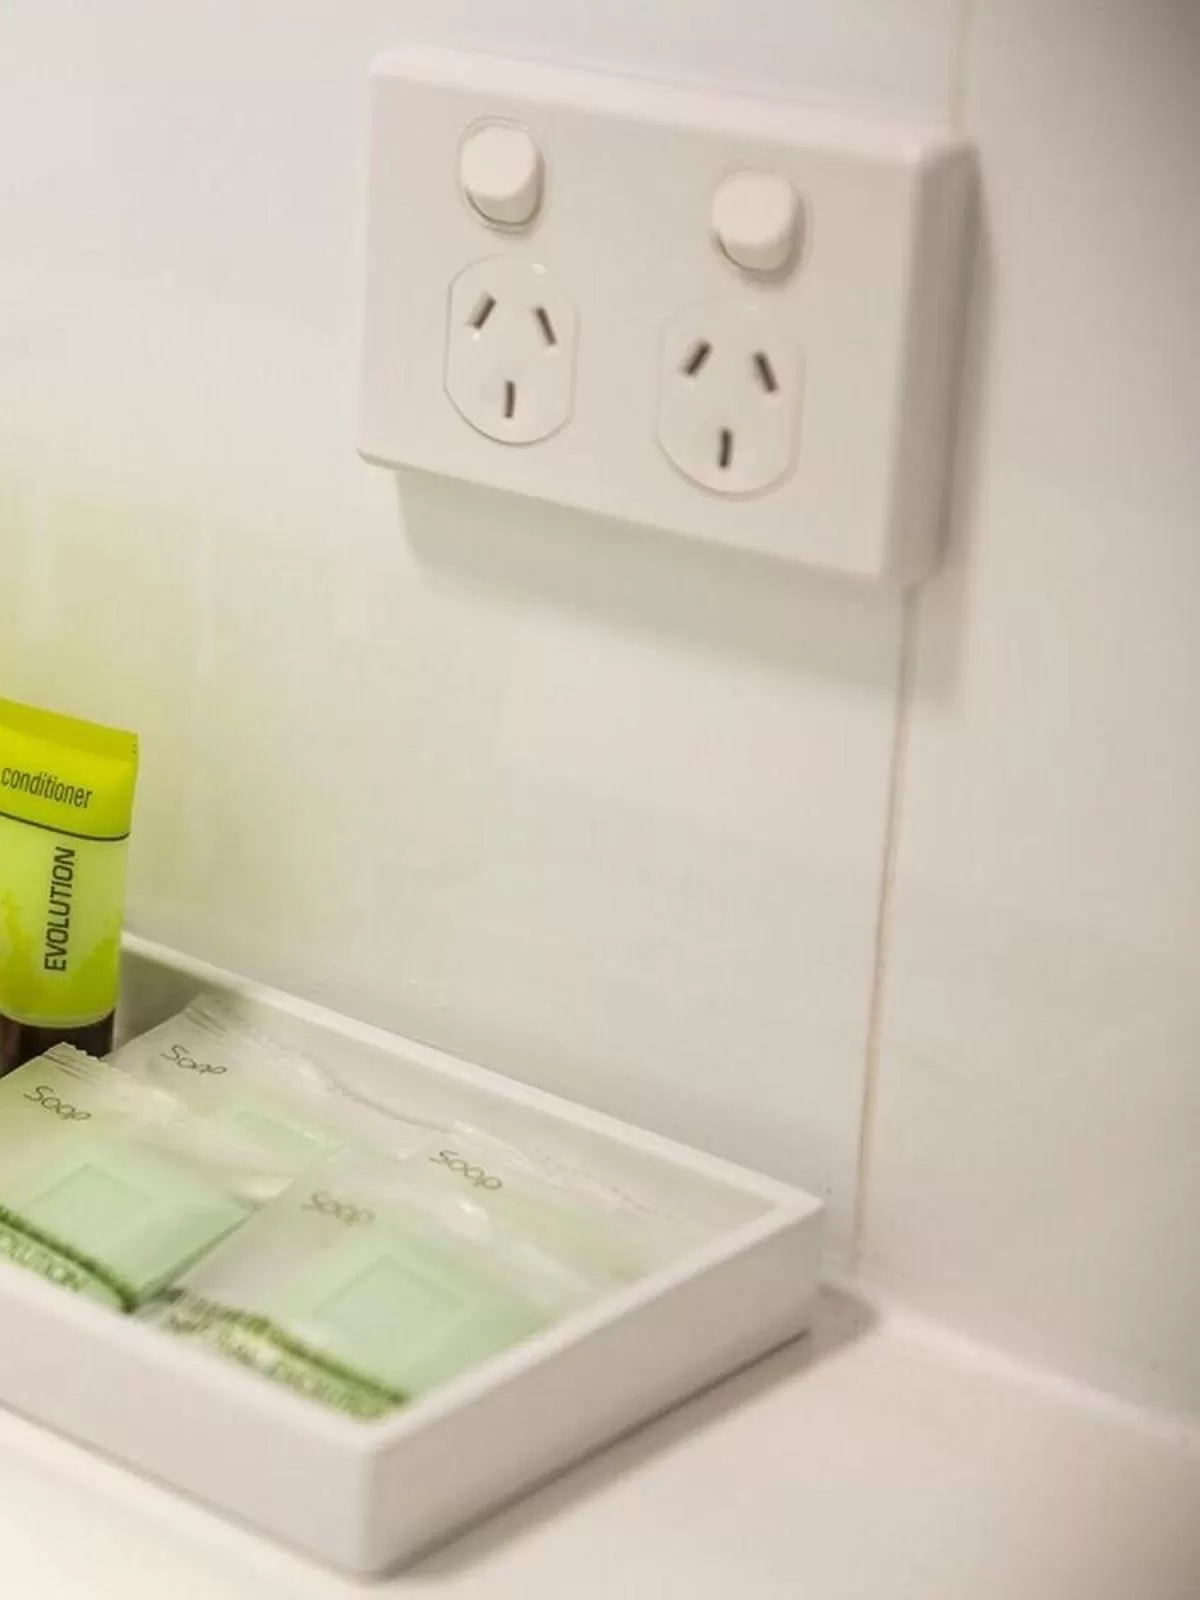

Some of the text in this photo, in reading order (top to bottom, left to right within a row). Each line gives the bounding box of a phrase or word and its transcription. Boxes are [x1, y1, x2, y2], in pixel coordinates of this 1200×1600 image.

[0, 766, 93, 809] conditioner
[44, 846, 75, 972] EVOLUTION
[160, 1044, 227, 1076] Soap
[23, 1084, 91, 1123] Soap
[429, 1148, 502, 1191] Soap
